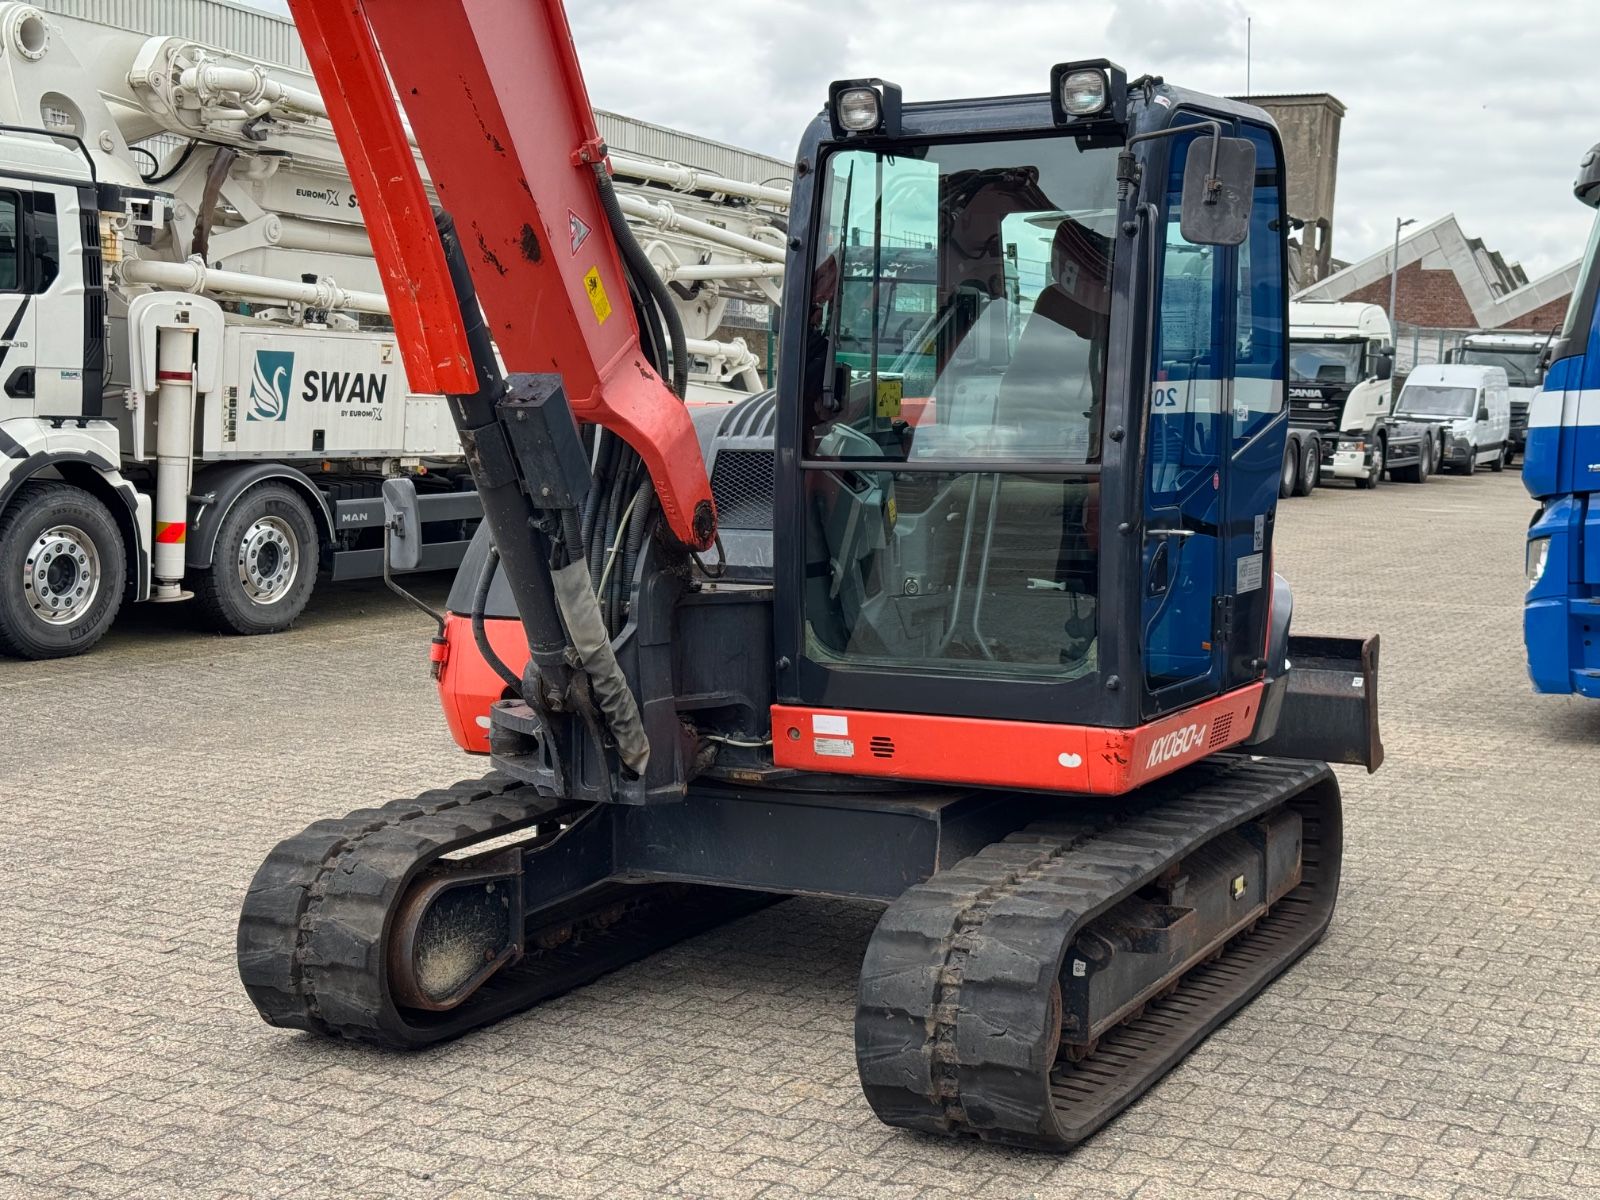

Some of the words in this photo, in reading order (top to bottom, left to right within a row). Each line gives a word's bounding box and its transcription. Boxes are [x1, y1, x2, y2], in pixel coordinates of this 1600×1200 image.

[296, 188, 340, 207] EUROMIX
[347, 194, 360, 209] S
[302, 370, 387, 404] SWAN
[1289, 388, 1323, 398] CANIA
[350, 407, 383, 421] EUROMIX
[342, 512, 368, 523] MAN
[1145, 723, 1207, 770] KX080-4
